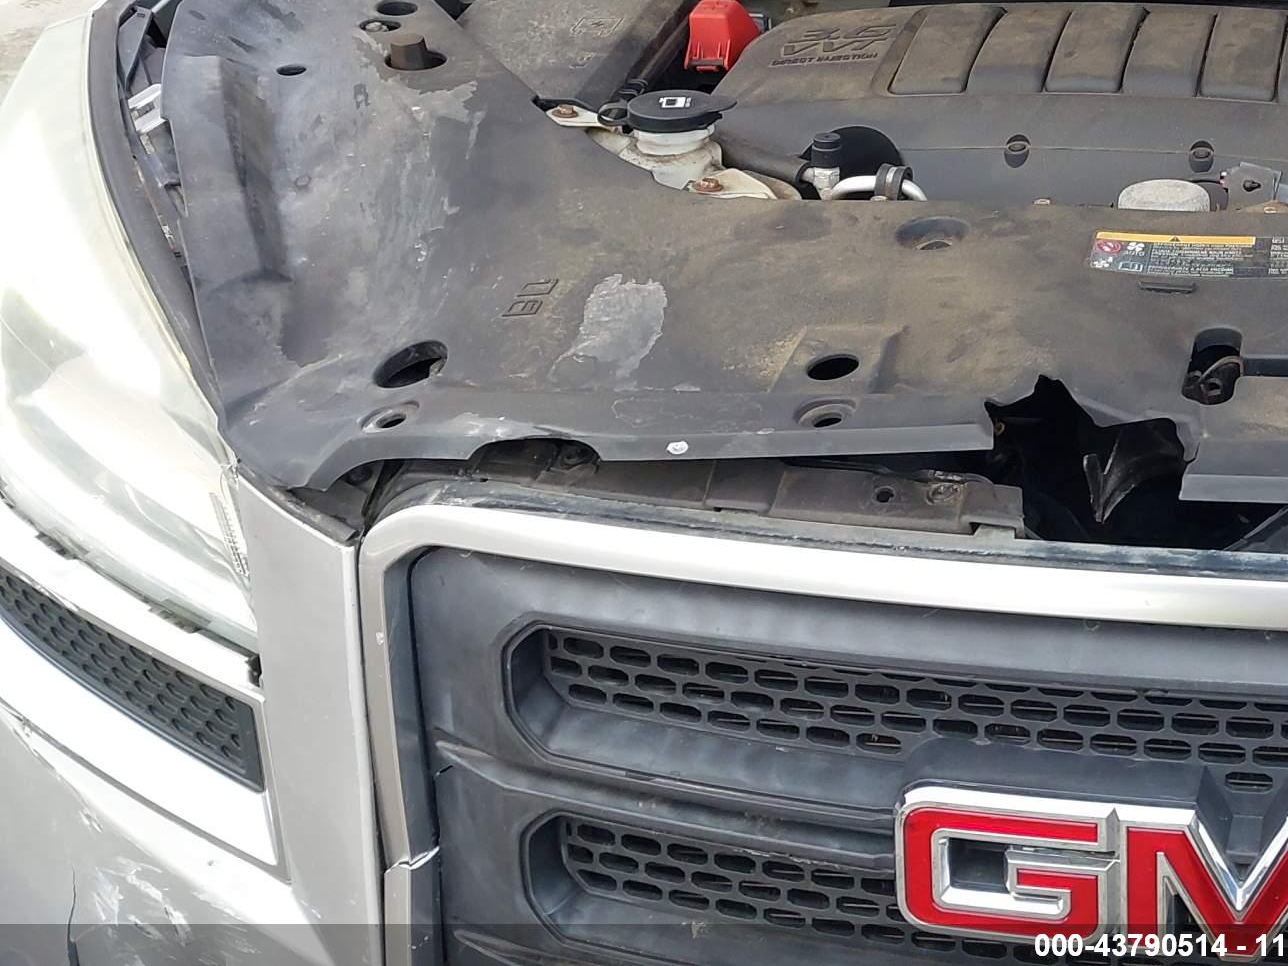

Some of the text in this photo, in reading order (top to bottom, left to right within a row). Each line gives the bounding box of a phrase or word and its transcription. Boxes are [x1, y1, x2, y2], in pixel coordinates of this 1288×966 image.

[783, 37, 888, 56] VVT
[771, 52, 878, 67] DIRECT INJECTION
